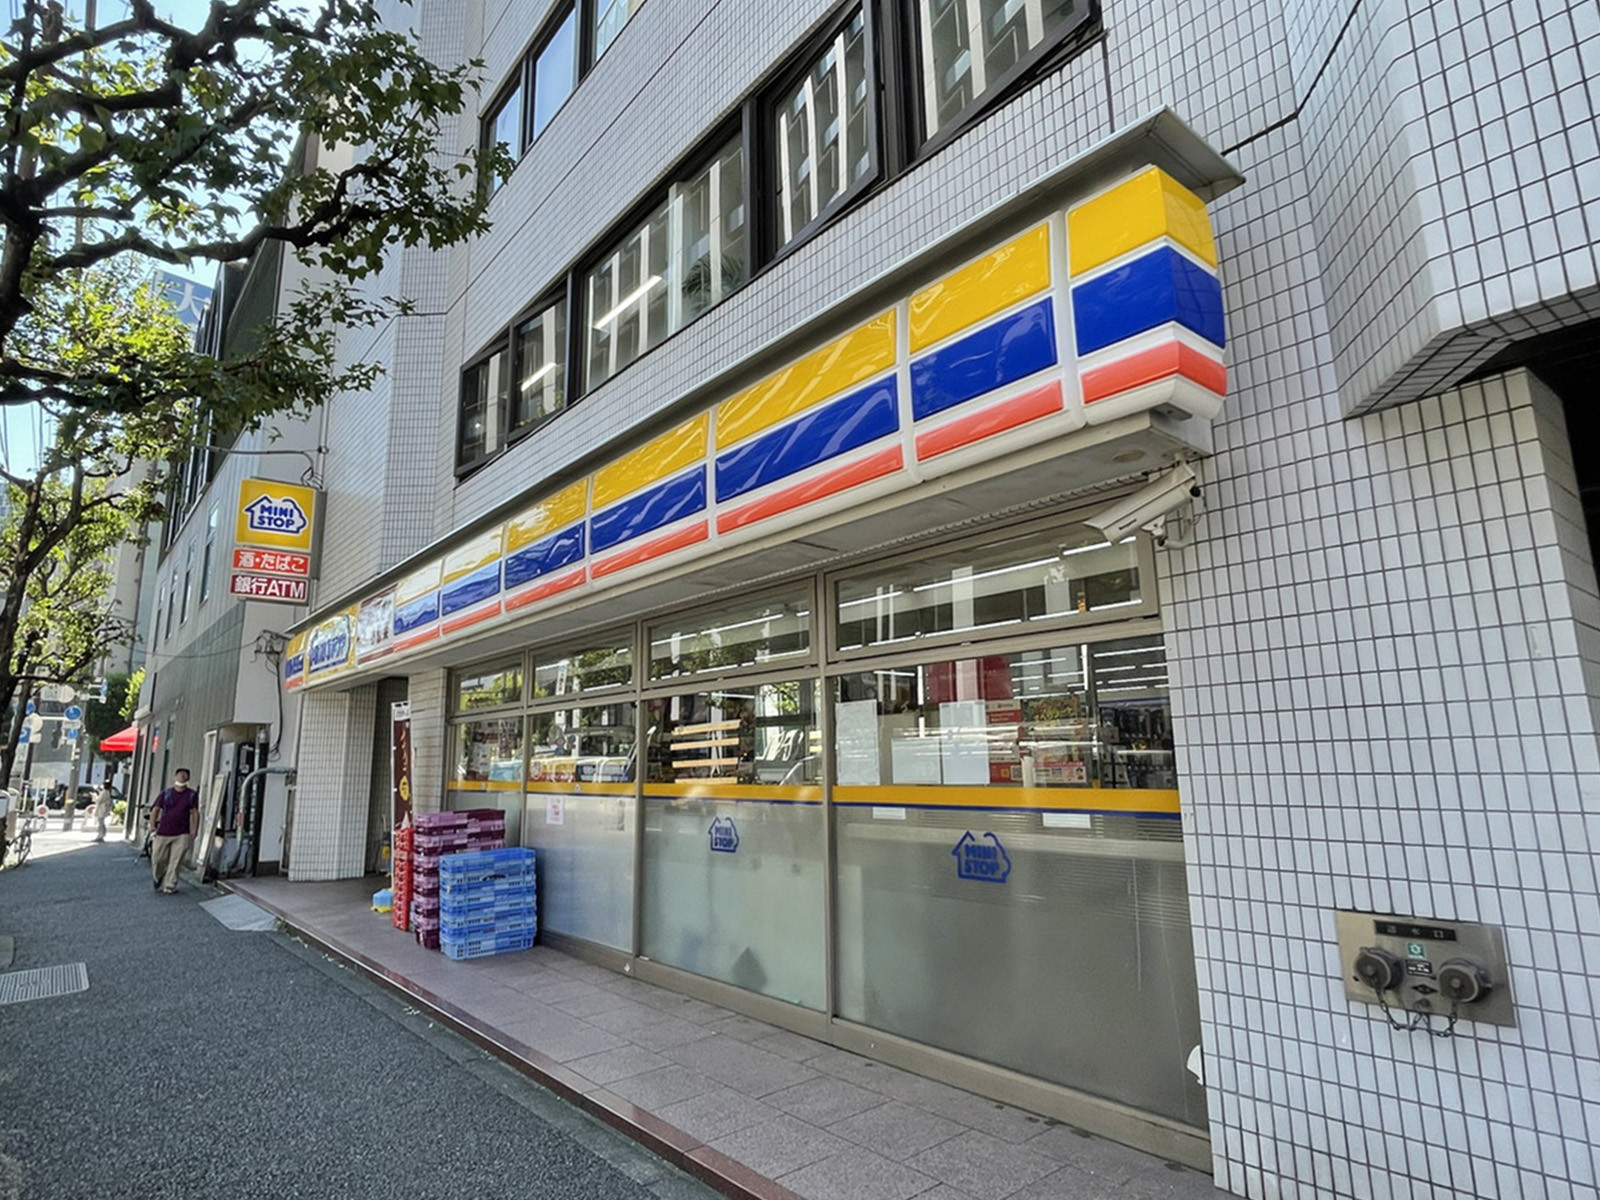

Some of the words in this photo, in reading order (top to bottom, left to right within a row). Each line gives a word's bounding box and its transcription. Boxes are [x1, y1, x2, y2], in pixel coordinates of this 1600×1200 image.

[260, 504, 293, 517] MINI
[257, 516, 294, 528] STOP
[239, 551, 305, 572] 酒・たばこ
[235, 576, 304, 598] 銀行ATM
[714, 837, 735, 848] STOP
[964, 843, 998, 860] MINI
[964, 859, 1000, 876] STOP
